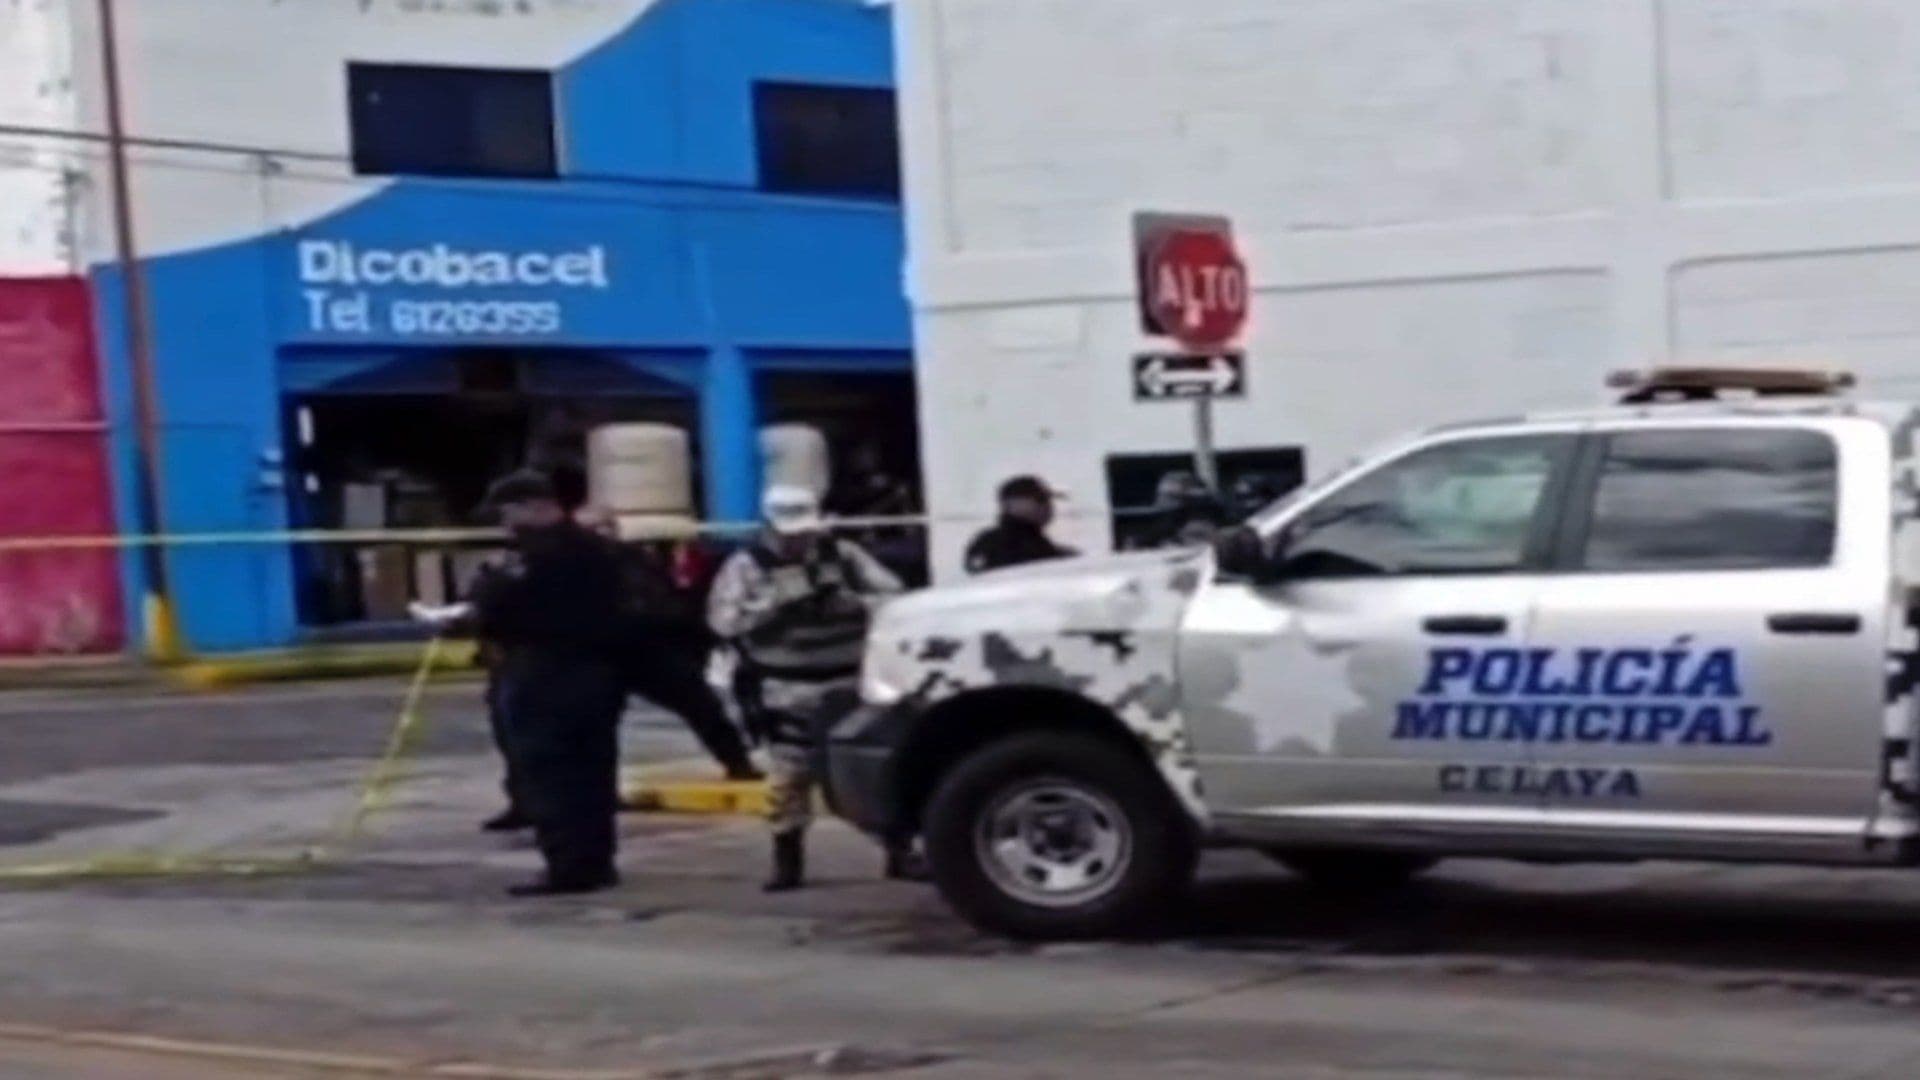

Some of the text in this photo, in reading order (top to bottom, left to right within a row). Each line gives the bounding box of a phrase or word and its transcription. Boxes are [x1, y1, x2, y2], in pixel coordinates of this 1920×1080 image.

[304, 289, 369, 331] Tel
[1158, 262, 1242, 312] ALTO
[1417, 634, 1741, 696] POLICÍA
[1390, 700, 1773, 746] MUNICIPAL
[1438, 764, 1641, 797] CELAYA
